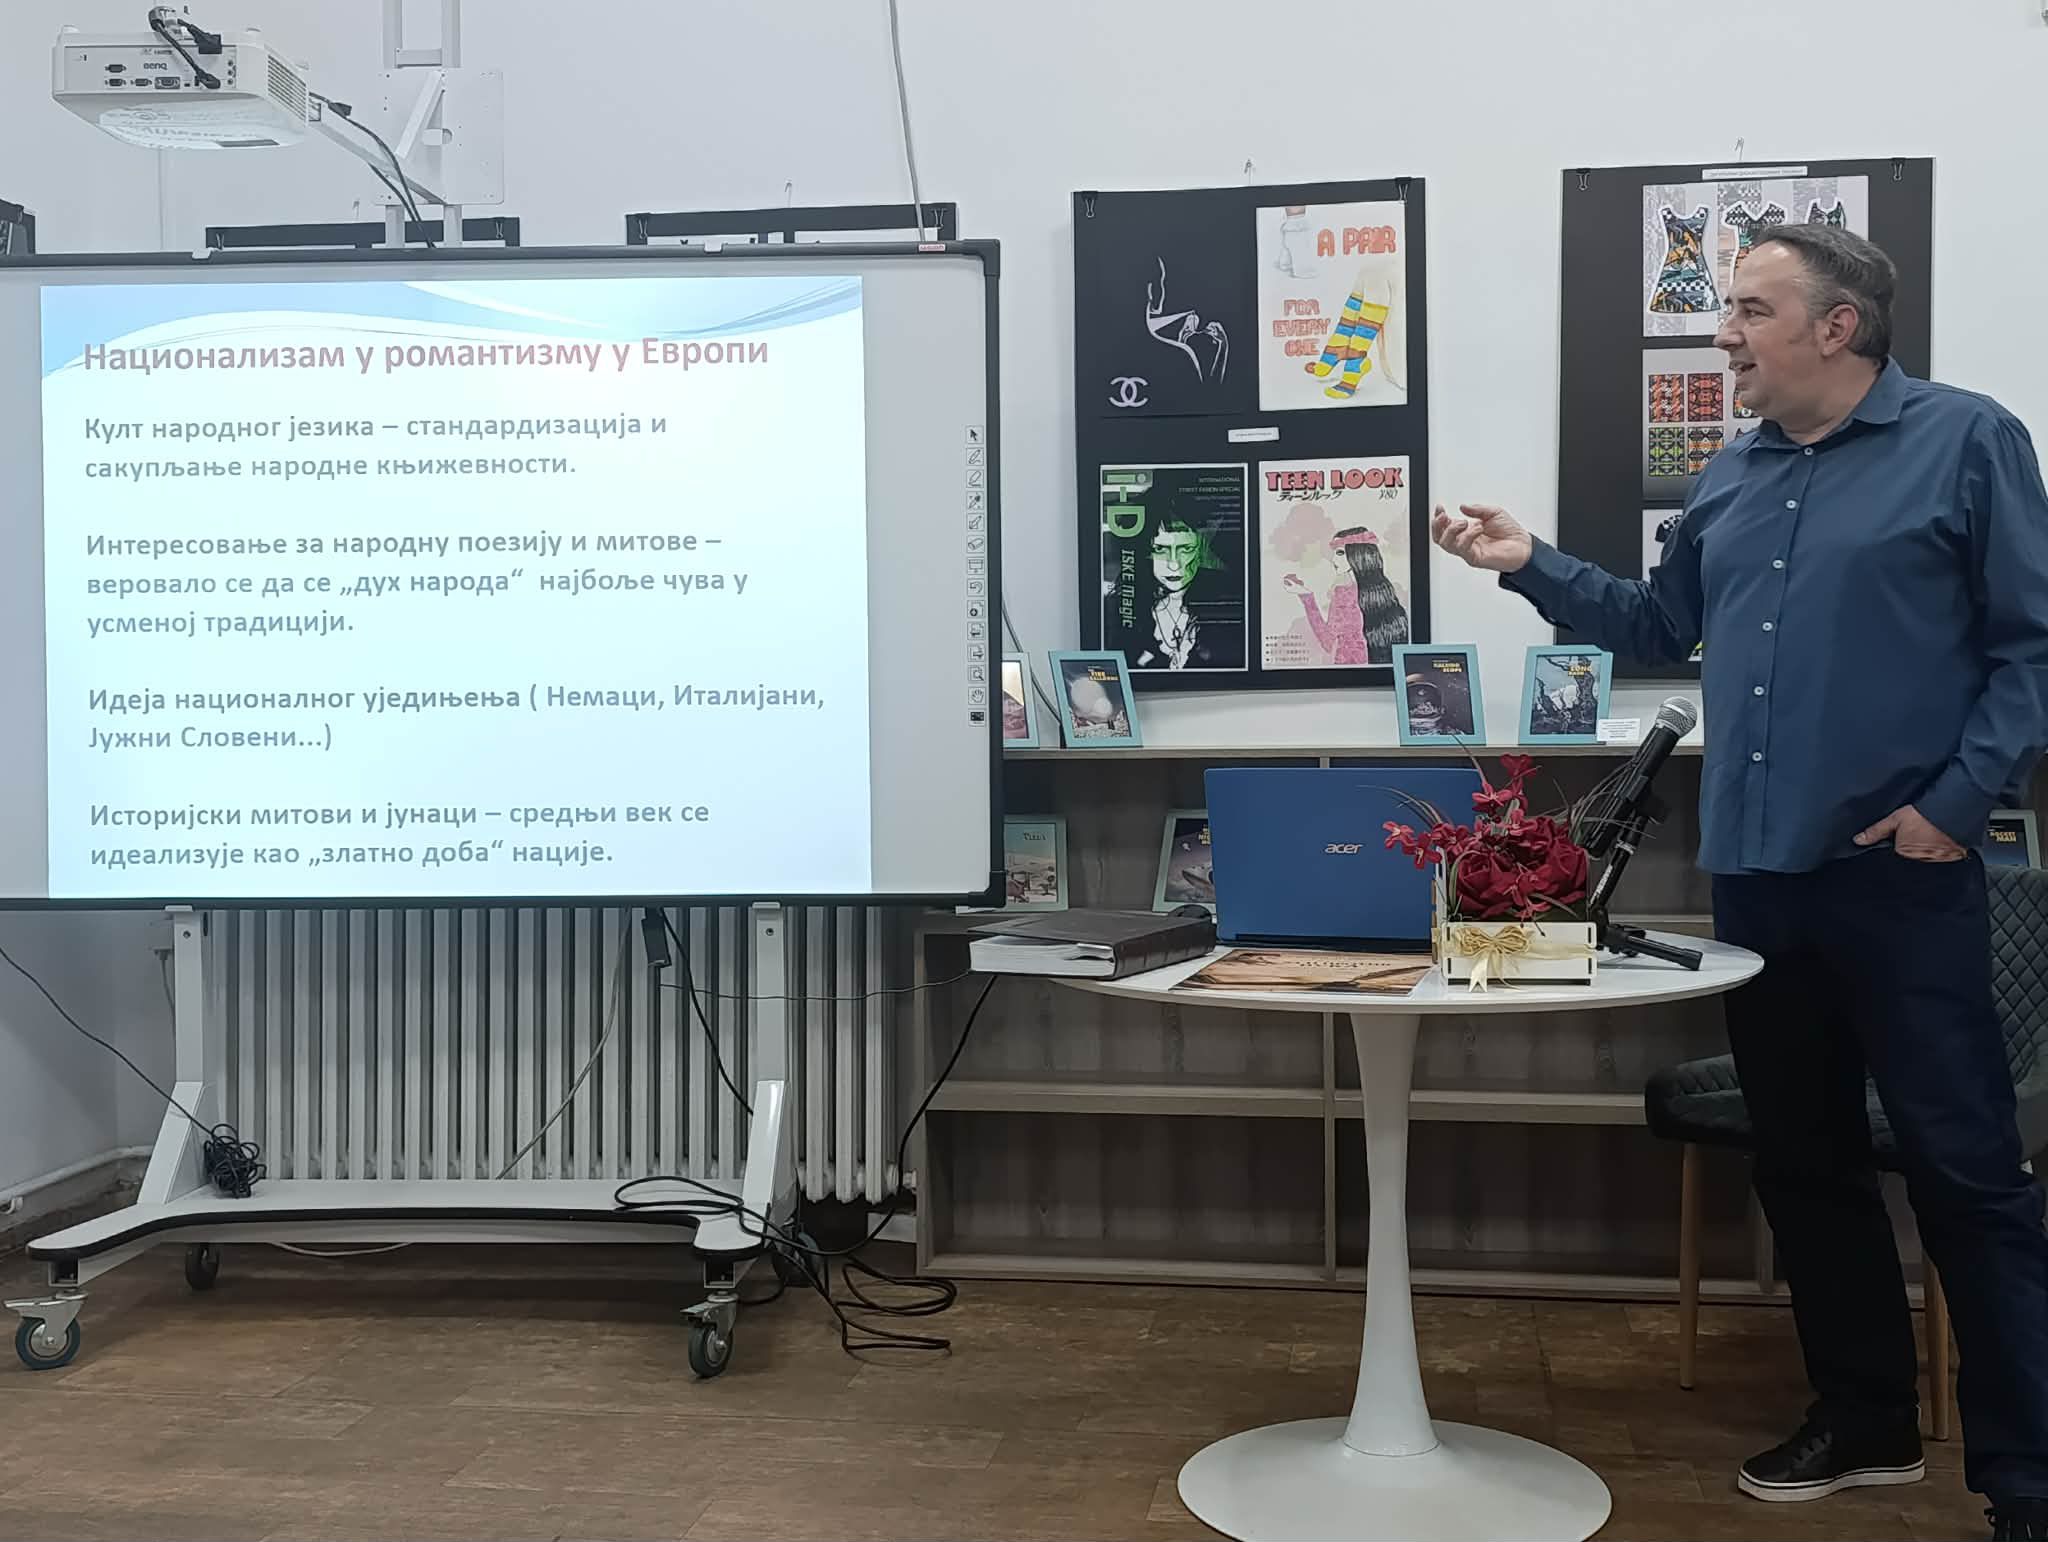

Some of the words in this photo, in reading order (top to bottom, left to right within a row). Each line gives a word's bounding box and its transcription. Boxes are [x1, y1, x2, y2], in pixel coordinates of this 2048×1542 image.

[1317, 228, 1335, 257] A
[1343, 225, 1396, 255] PAIR
[1284, 299, 1320, 316] FOR
[1272, 318, 1331, 337] EVERY
[83, 342, 345, 376] Национализам
[354, 346, 375, 375] у
[385, 342, 602, 375] романтизму
[612, 343, 630, 373] у
[642, 337, 768, 372] Европи
[1284, 339, 1320, 356] ONE
[85, 417, 144, 445] Култ
[152, 419, 282, 444] народног
[286, 415, 374, 442] језика
[406, 412, 641, 441] стандардизација
[651, 417, 666, 433] и
[85, 460, 242, 483] сакупљање
[251, 459, 368, 481] народне
[377, 456, 576, 475] књижевности.
[1265, 471, 1324, 491] TEEN
[1331, 467, 1404, 489] LOOK
[87, 535, 288, 561] Интересовање
[295, 537, 324, 554] за
[333, 536, 450, 558] народну
[458, 530, 563, 557] поезију
[571, 535, 587, 552] и
[596, 535, 697, 552] митове
[1121, 549, 1135, 581] ISKE
[87, 577, 217, 600] веровало
[225, 577, 253, 593] се
[261, 577, 294, 599] да
[303, 576, 331, 593] се
[339, 575, 401, 597] „дух
[410, 567, 524, 597] народа“
[540, 567, 655, 597] најбоље
[663, 574, 725, 596] чува
[732, 573, 749, 595] у
[87, 610, 195, 639] усменој
[203, 609, 354, 638] традицији.
[89, 687, 166, 716] Идеја
[175, 692, 356, 715] националног
[362, 685, 520, 714] уједињења
[529, 683, 537, 712] (
[547, 685, 665, 712] Немаци,
[674, 683, 824, 711] Италијани,
[88, 727, 171, 754] Јужни
[180, 722, 332, 752] Словени...)
[91, 803, 241, 831] Историјски
[250, 808, 352, 825] митови
[361, 807, 377, 824] и
[384, 801, 477, 830] јунаци
[509, 806, 617, 829] средњи
[626, 805, 673, 823] век
[680, 806, 709, 822] се
[91, 841, 244, 871] идеализује
[253, 847, 300, 864] као
[308, 846, 414, 868] „златно
[421, 839, 504, 868] доба“
[512, 839, 613, 867] нације.
[1325, 843, 1364, 854] acer
